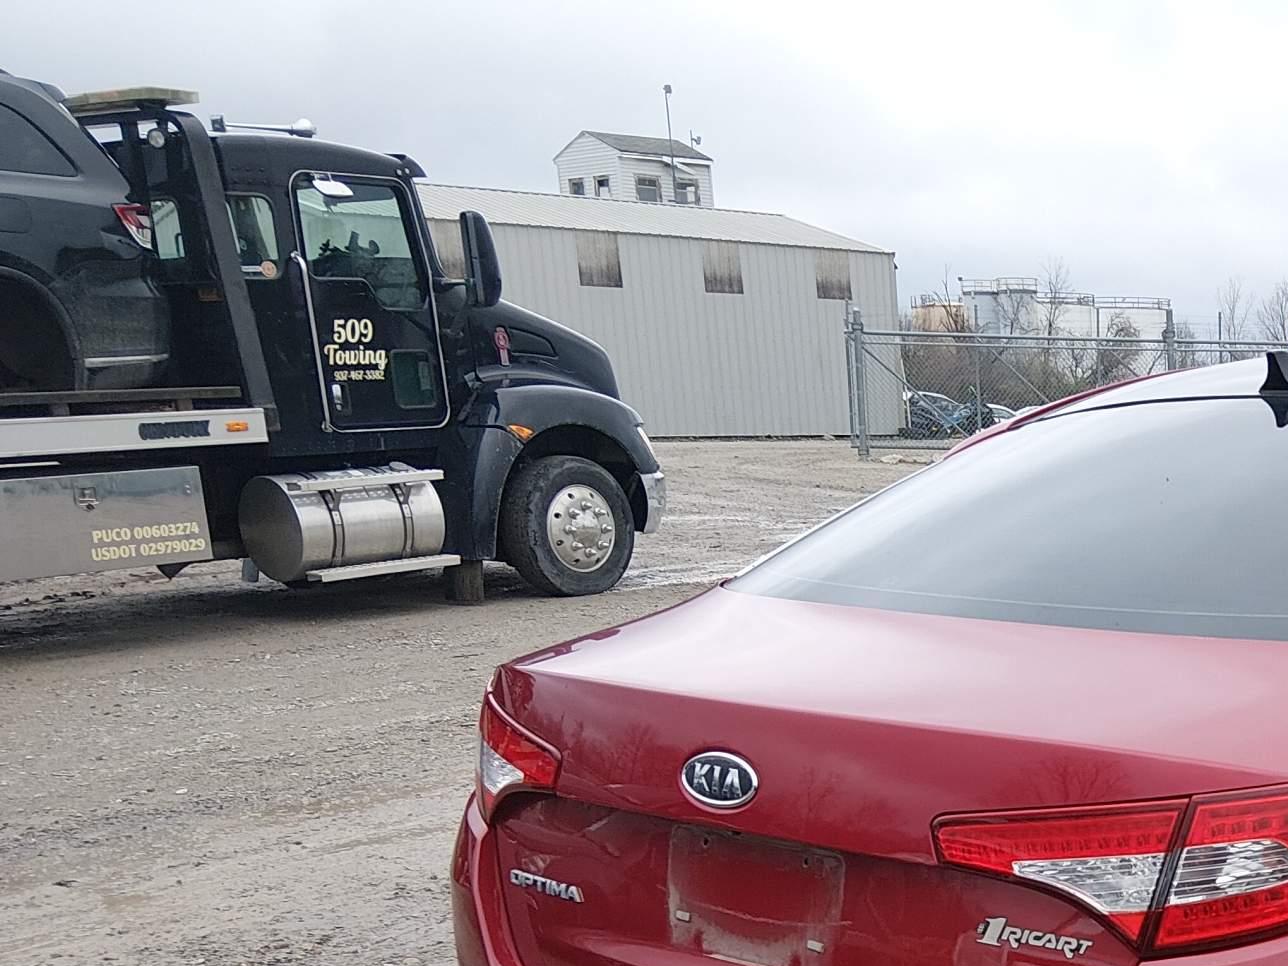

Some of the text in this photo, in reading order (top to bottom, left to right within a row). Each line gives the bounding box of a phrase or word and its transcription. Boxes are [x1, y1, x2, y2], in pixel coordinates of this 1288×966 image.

[333, 318, 373, 343] 509
[323, 344, 388, 370] Towing
[92, 521, 200, 543] PUCO 00603274
[91, 538, 206, 561] USDOT 02979029
[693, 761, 743, 798] KIA
[509, 868, 585, 903] OPTIMA
